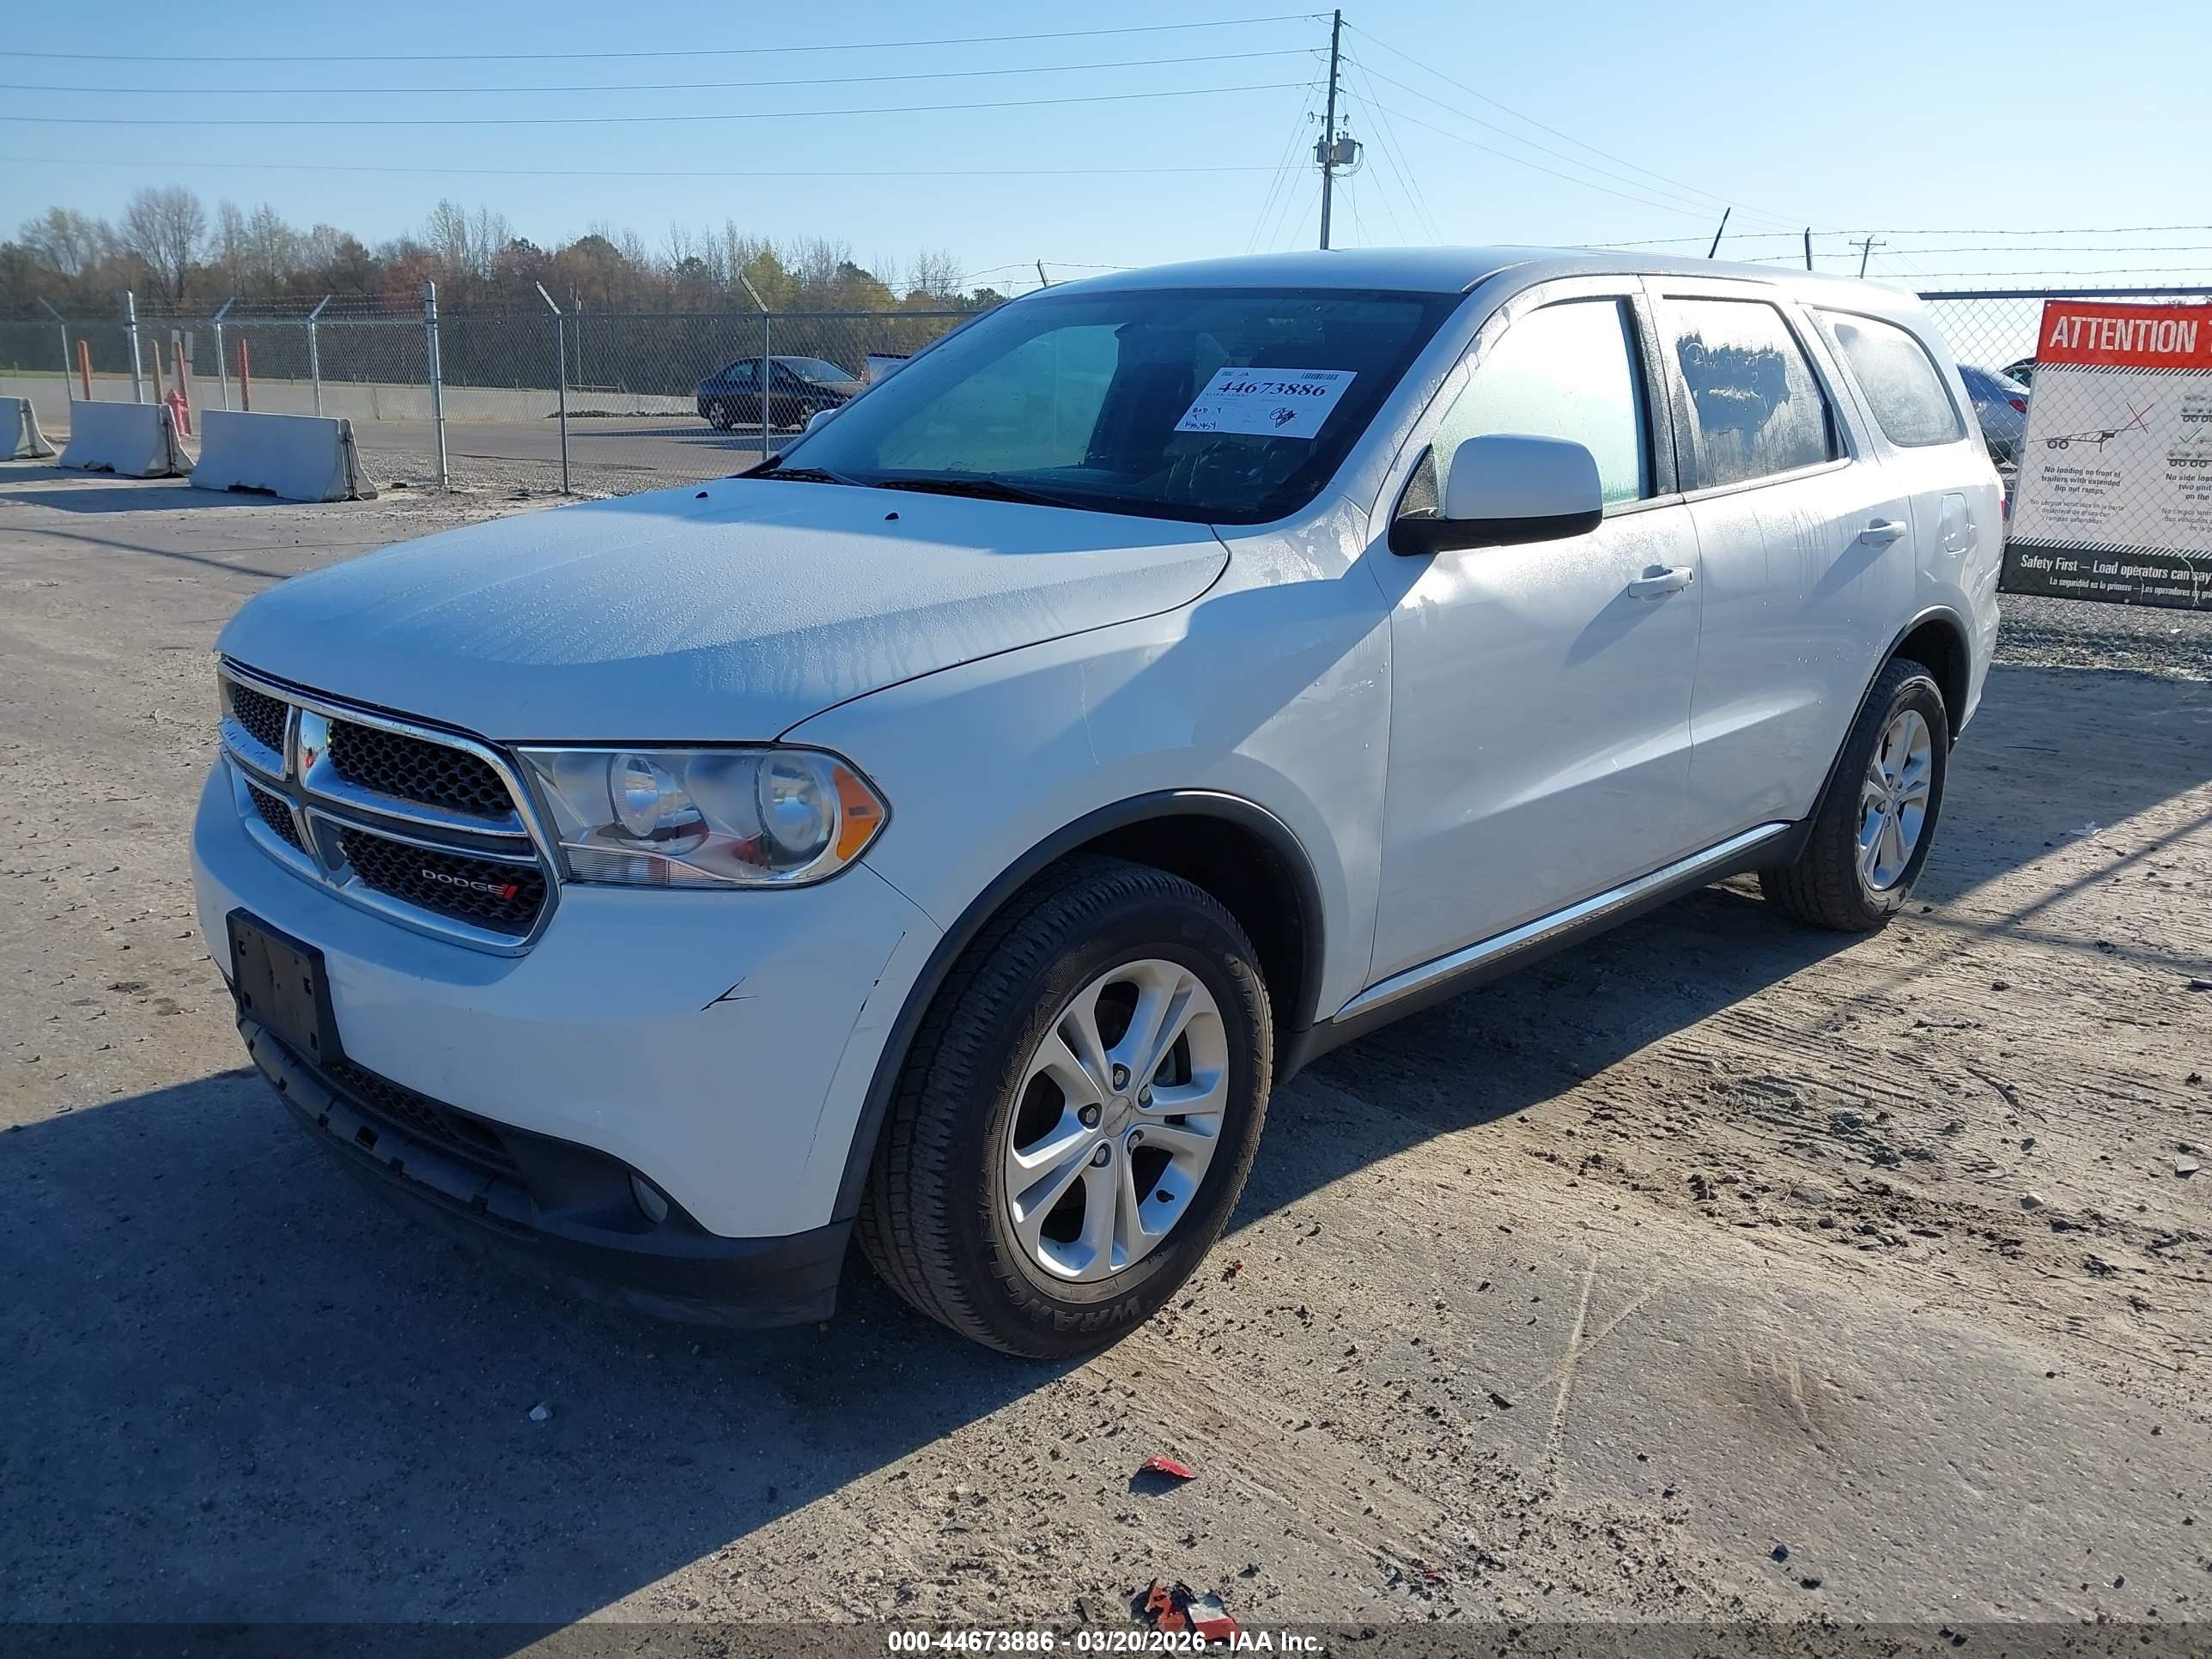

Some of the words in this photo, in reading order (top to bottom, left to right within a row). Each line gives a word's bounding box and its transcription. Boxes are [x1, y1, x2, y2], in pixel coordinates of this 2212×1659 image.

[2049, 315, 2198, 353] ATTENTION
[1218, 380, 1329, 397] 44673886
[2057, 466, 2084, 477] loading
[2096, 469, 2112, 477] front
[2087, 478, 2121, 487] extended
[2021, 554, 2053, 572] Safety
[2055, 556, 2078, 572] First
[2093, 560, 2118, 574] Load
[2120, 565, 2169, 579] operators
[2171, 569, 2190, 580] can
[2192, 570, 2212, 586] say
[2049, 576, 2057, 585] La
[2058, 578, 2089, 588] seguridad
[2099, 580, 2106, 589] lo
[2106, 581, 2133, 592] primero
[2154, 586, 2191, 597] operadores
[422, 869, 505, 896] DODGE
